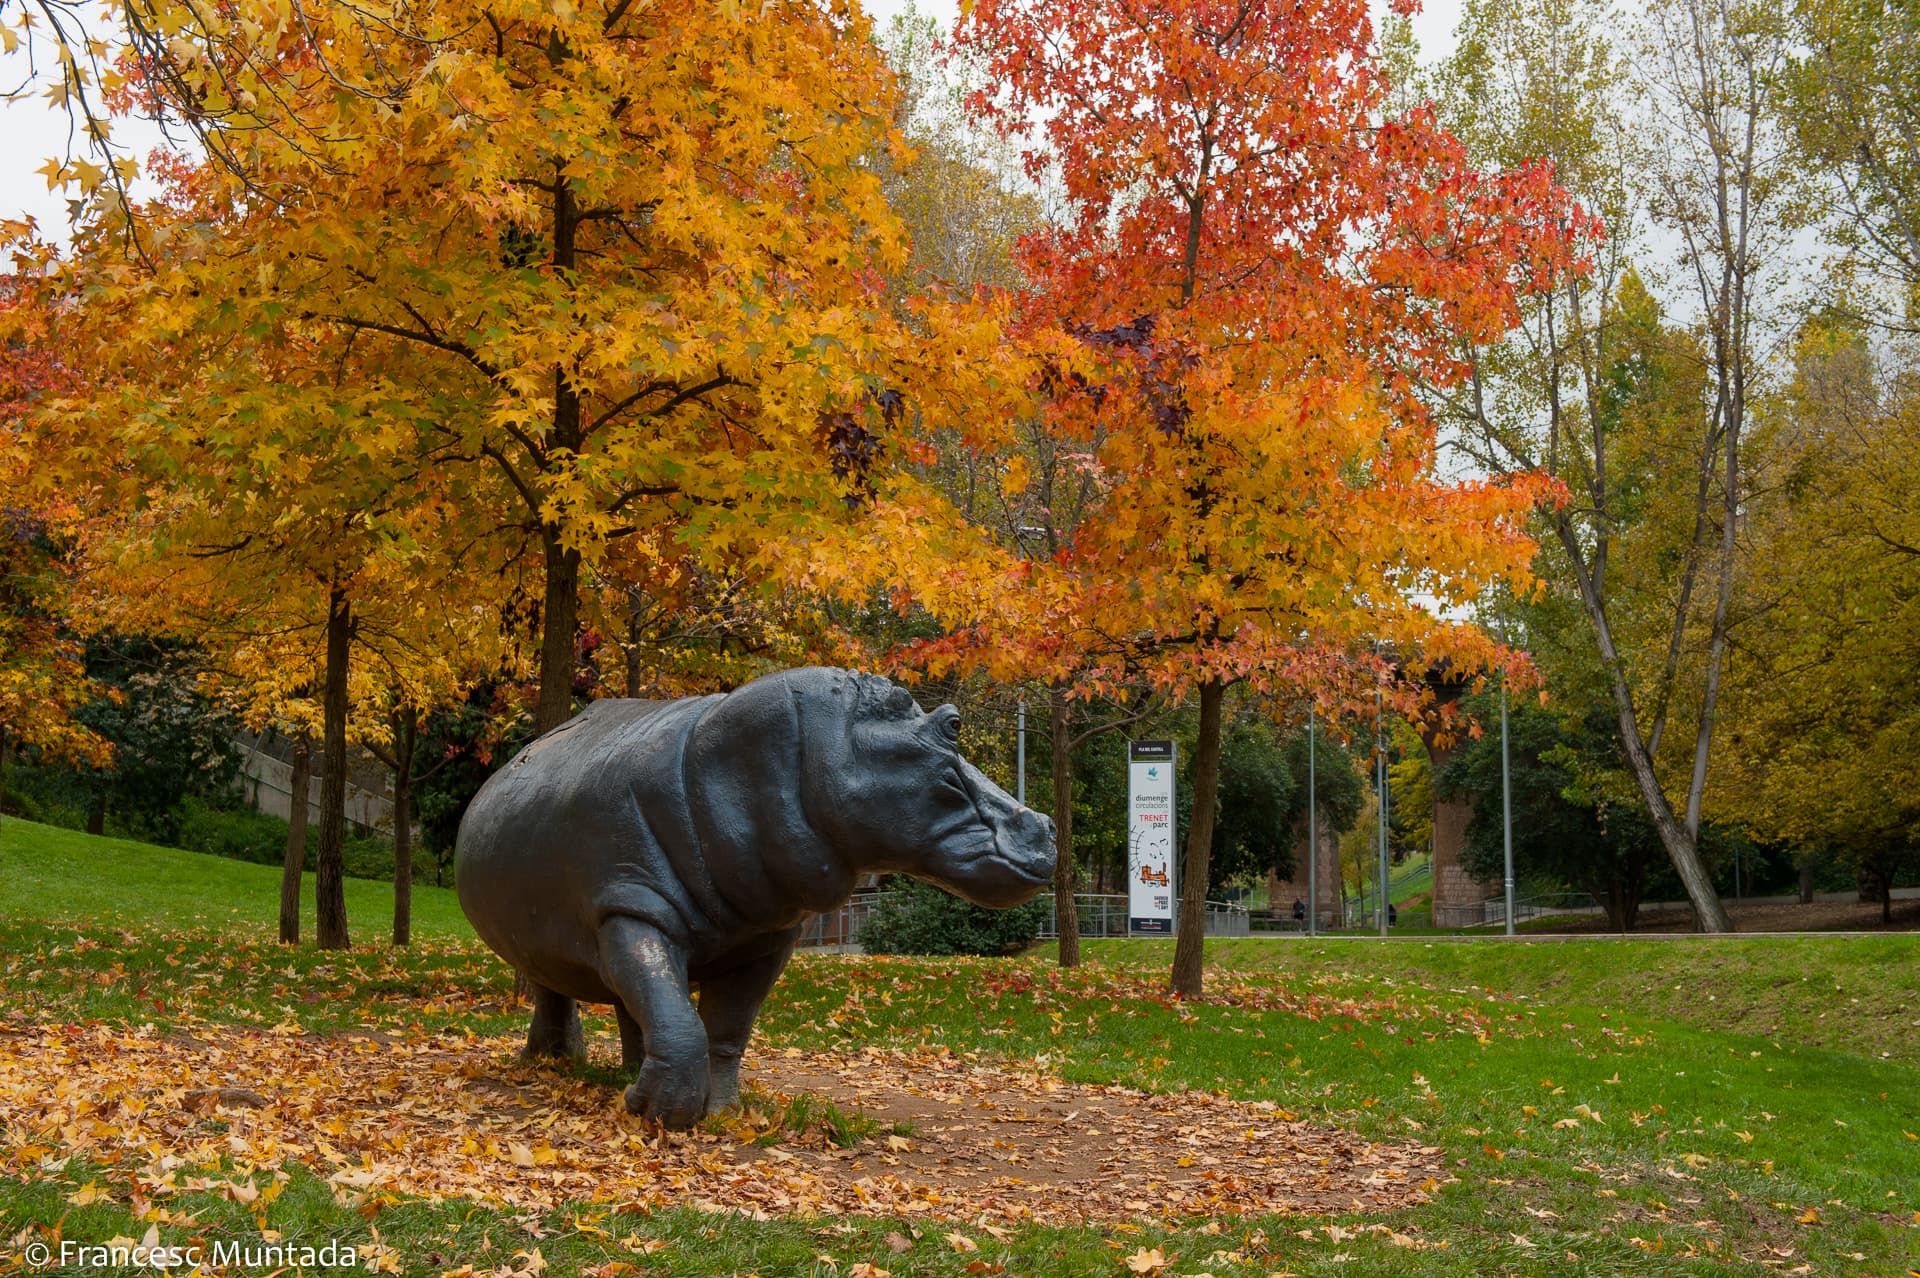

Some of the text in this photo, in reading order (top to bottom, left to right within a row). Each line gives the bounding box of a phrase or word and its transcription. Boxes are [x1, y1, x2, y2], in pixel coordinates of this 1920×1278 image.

[1135, 794, 1169, 804] diumenge
[1139, 814, 1169, 822] TRENET
[1152, 822, 1169, 830] parc
